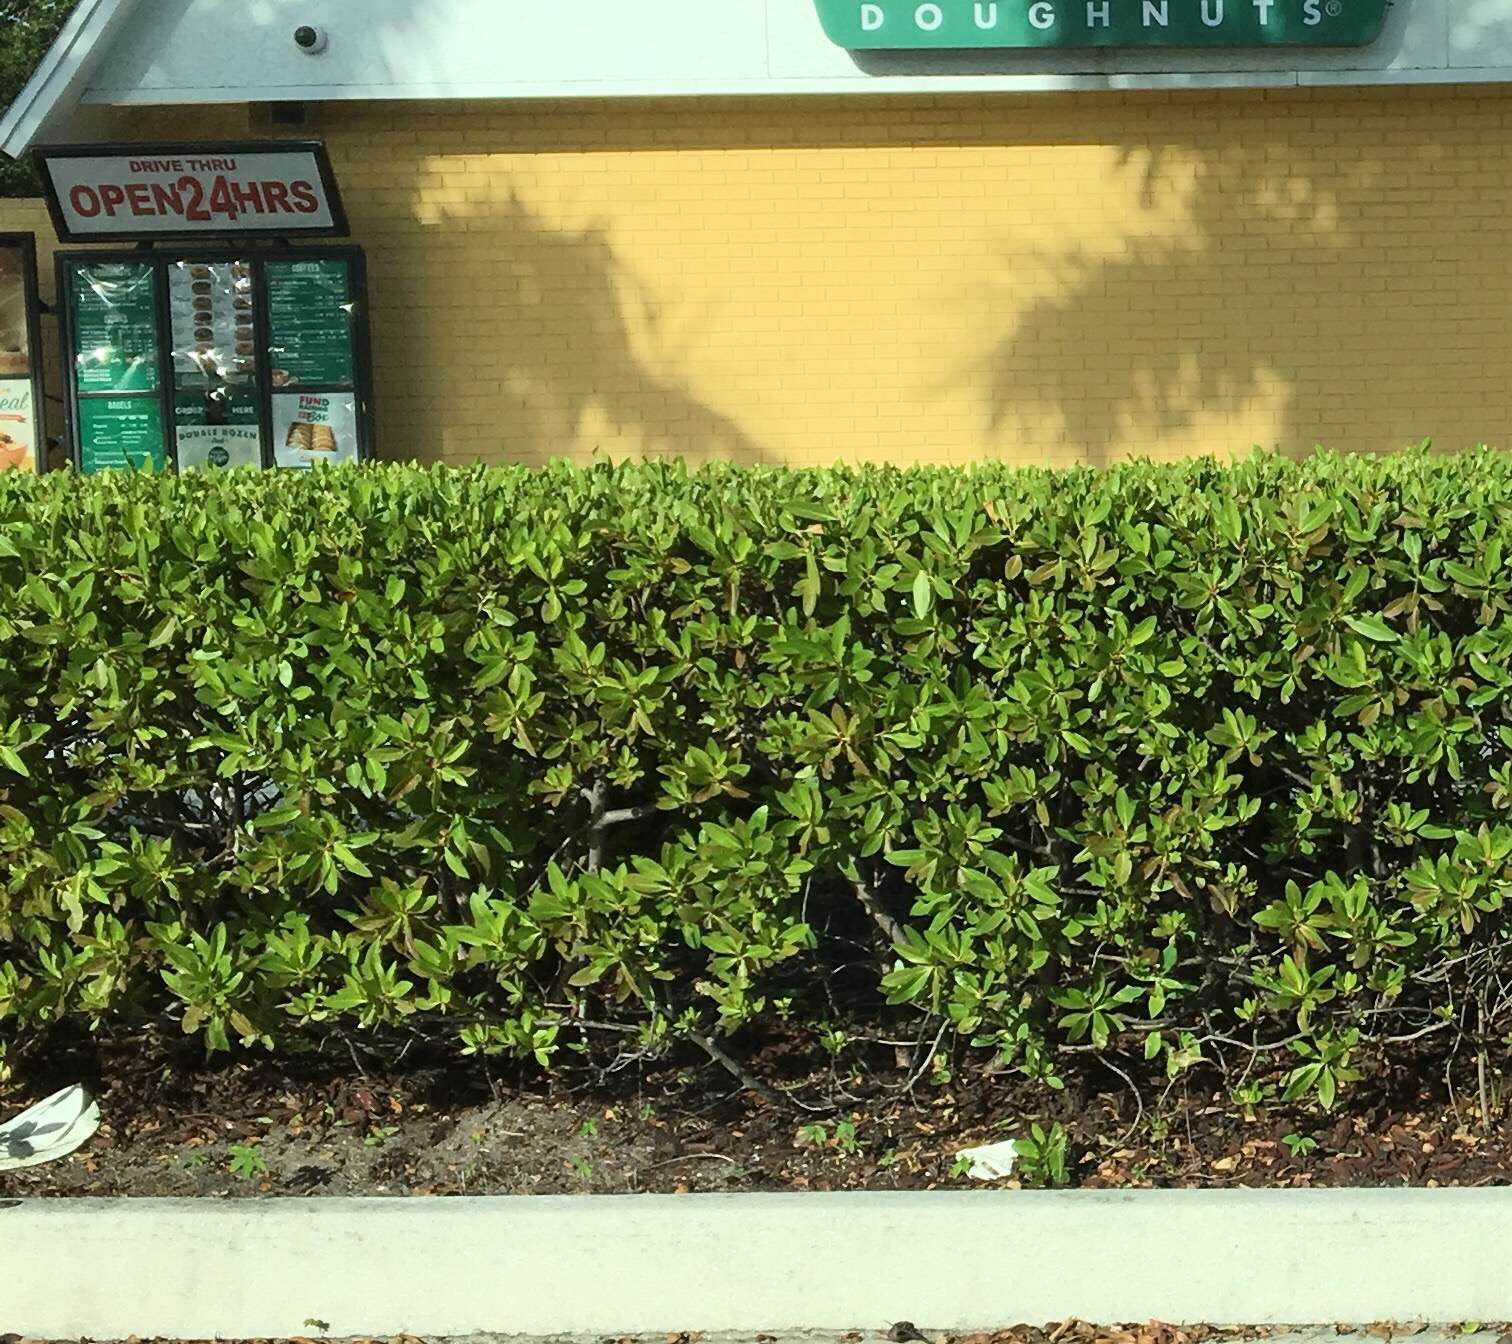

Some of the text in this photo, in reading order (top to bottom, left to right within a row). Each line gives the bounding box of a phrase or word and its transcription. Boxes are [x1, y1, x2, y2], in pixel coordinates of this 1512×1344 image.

[129, 158, 236, 174] DRIVE THRU
[222, 428, 257, 440] DOZEN
